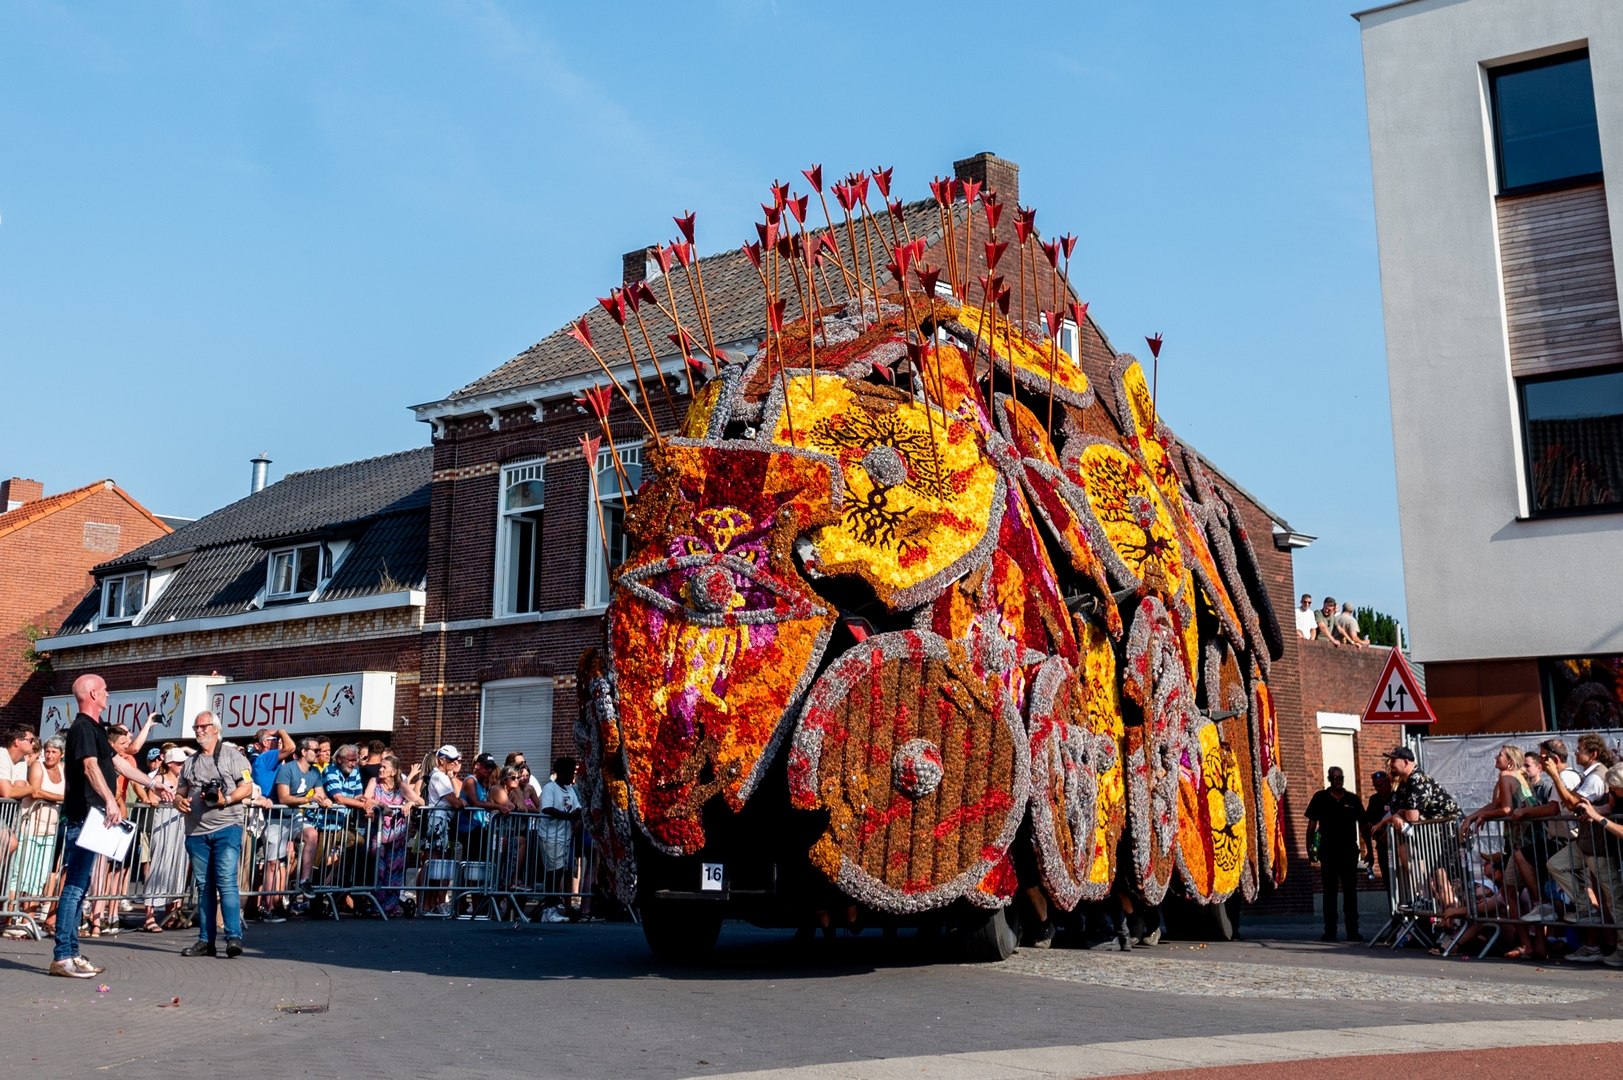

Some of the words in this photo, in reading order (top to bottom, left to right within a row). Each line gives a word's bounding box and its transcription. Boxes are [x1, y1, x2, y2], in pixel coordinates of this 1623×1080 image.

[107, 701, 156, 733] UCKY
[227, 691, 295, 728] SUSHI
[705, 866, 721, 881] 16
